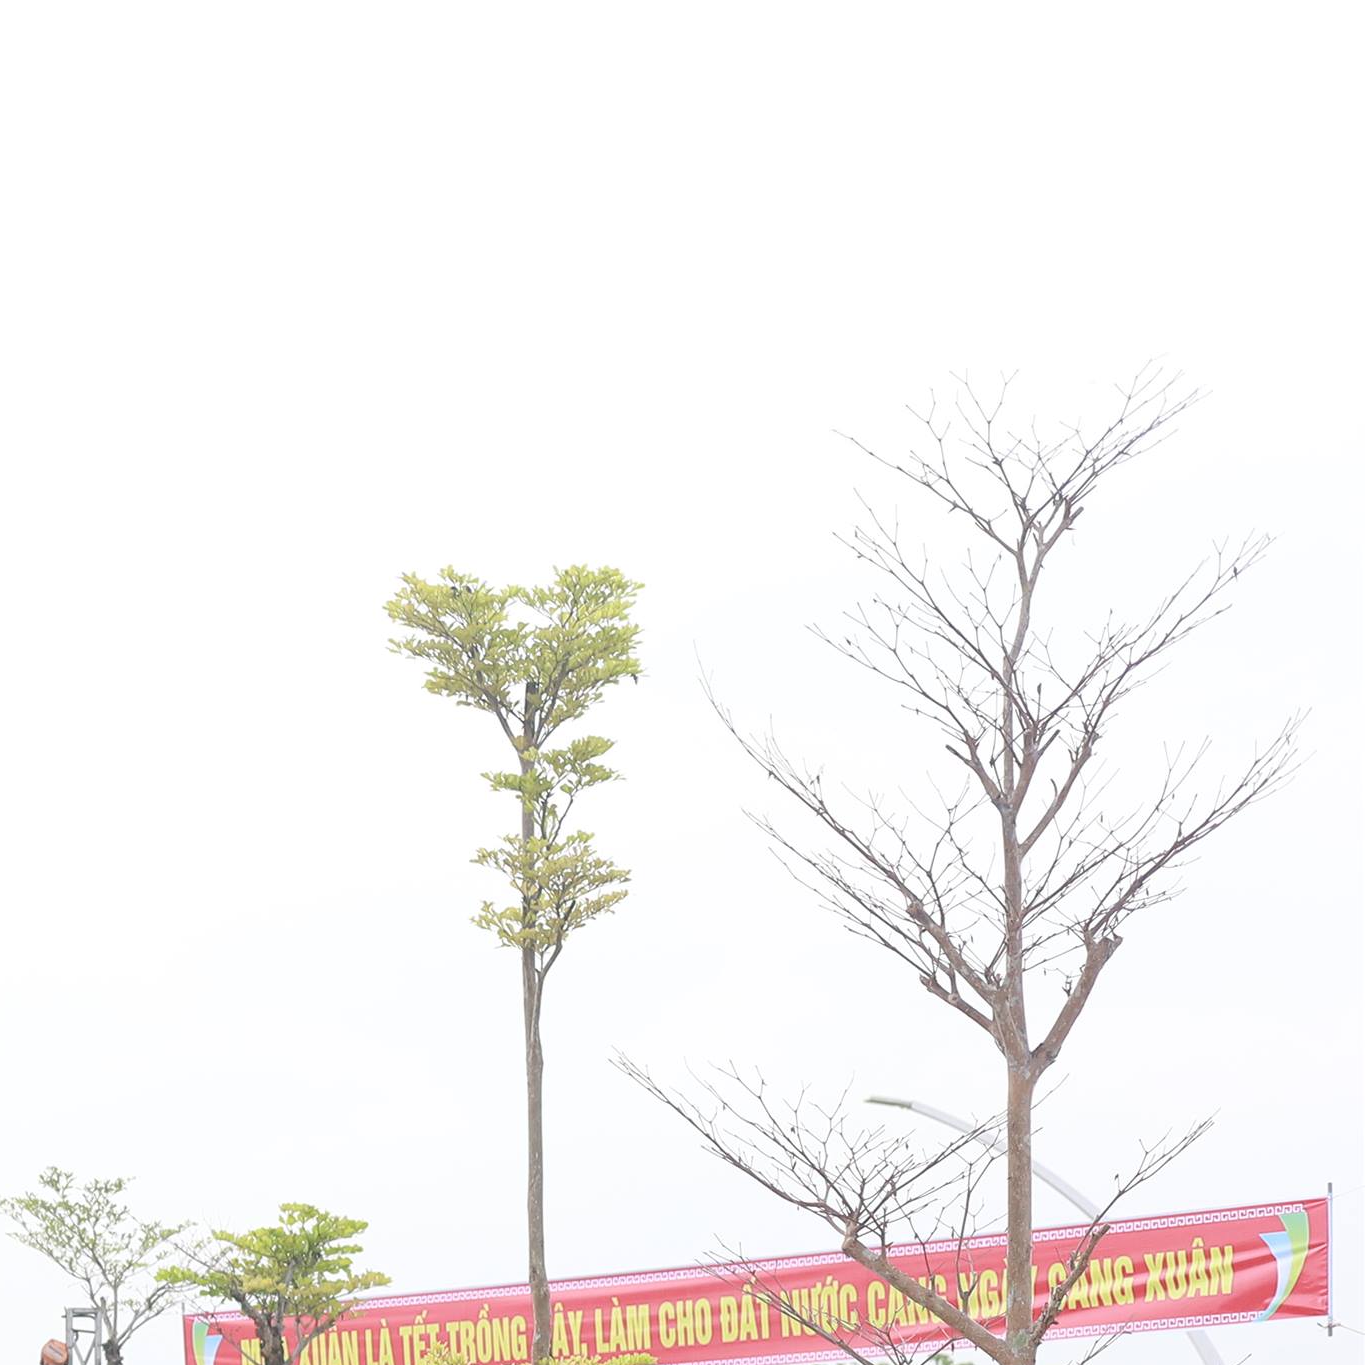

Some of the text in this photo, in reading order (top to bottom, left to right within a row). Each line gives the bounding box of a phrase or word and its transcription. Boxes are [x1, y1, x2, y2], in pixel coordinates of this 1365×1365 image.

[446, 1304, 528, 1364] TRỒNG
[552, 1302, 588, 1357] ÂY,
[595, 1297, 651, 1354] LÀM
[659, 1300, 713, 1346] CHO
[720, 1276, 770, 1343] ĐẤT
[780, 1275, 859, 1338] NƯỚC
[1144, 1237, 1233, 1302] XUÂN
